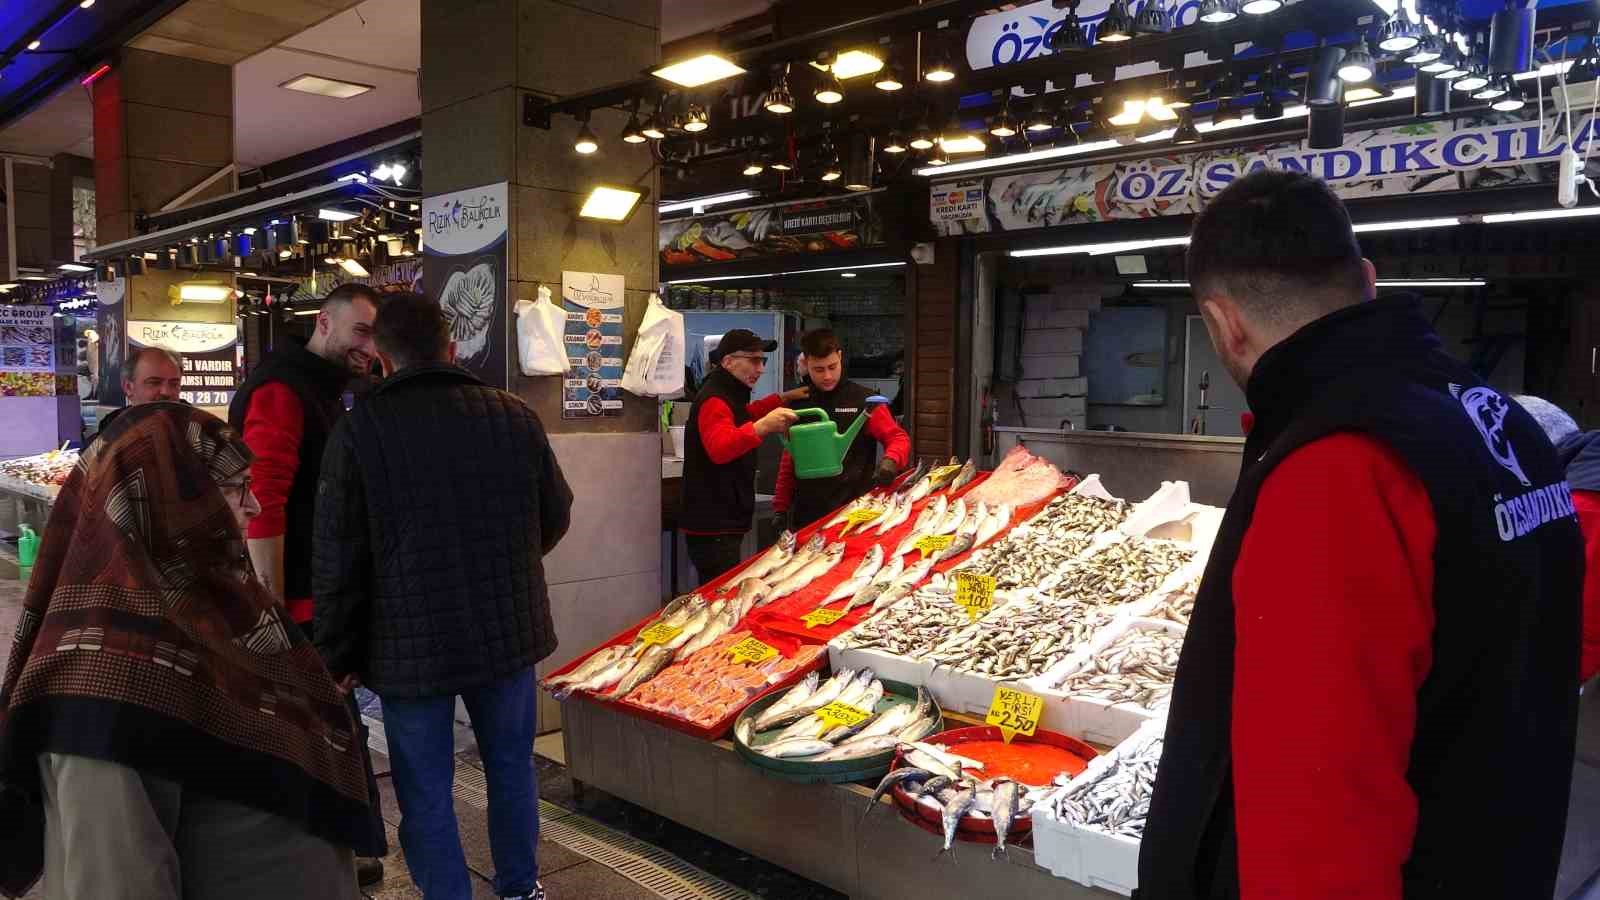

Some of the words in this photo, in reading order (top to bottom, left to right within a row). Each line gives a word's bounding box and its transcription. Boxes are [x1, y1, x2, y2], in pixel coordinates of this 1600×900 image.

[1120, 164, 1189, 200] ÖZ
[12, 310, 47, 319] GROUP
[195, 359, 233, 372] VARDIR
[180, 375, 203, 386] AMSI
[204, 376, 234, 386] VARDIR
[196, 391, 211, 404] 28
[214, 391, 228, 404] 70
[1000, 711, 1035, 732] 250
